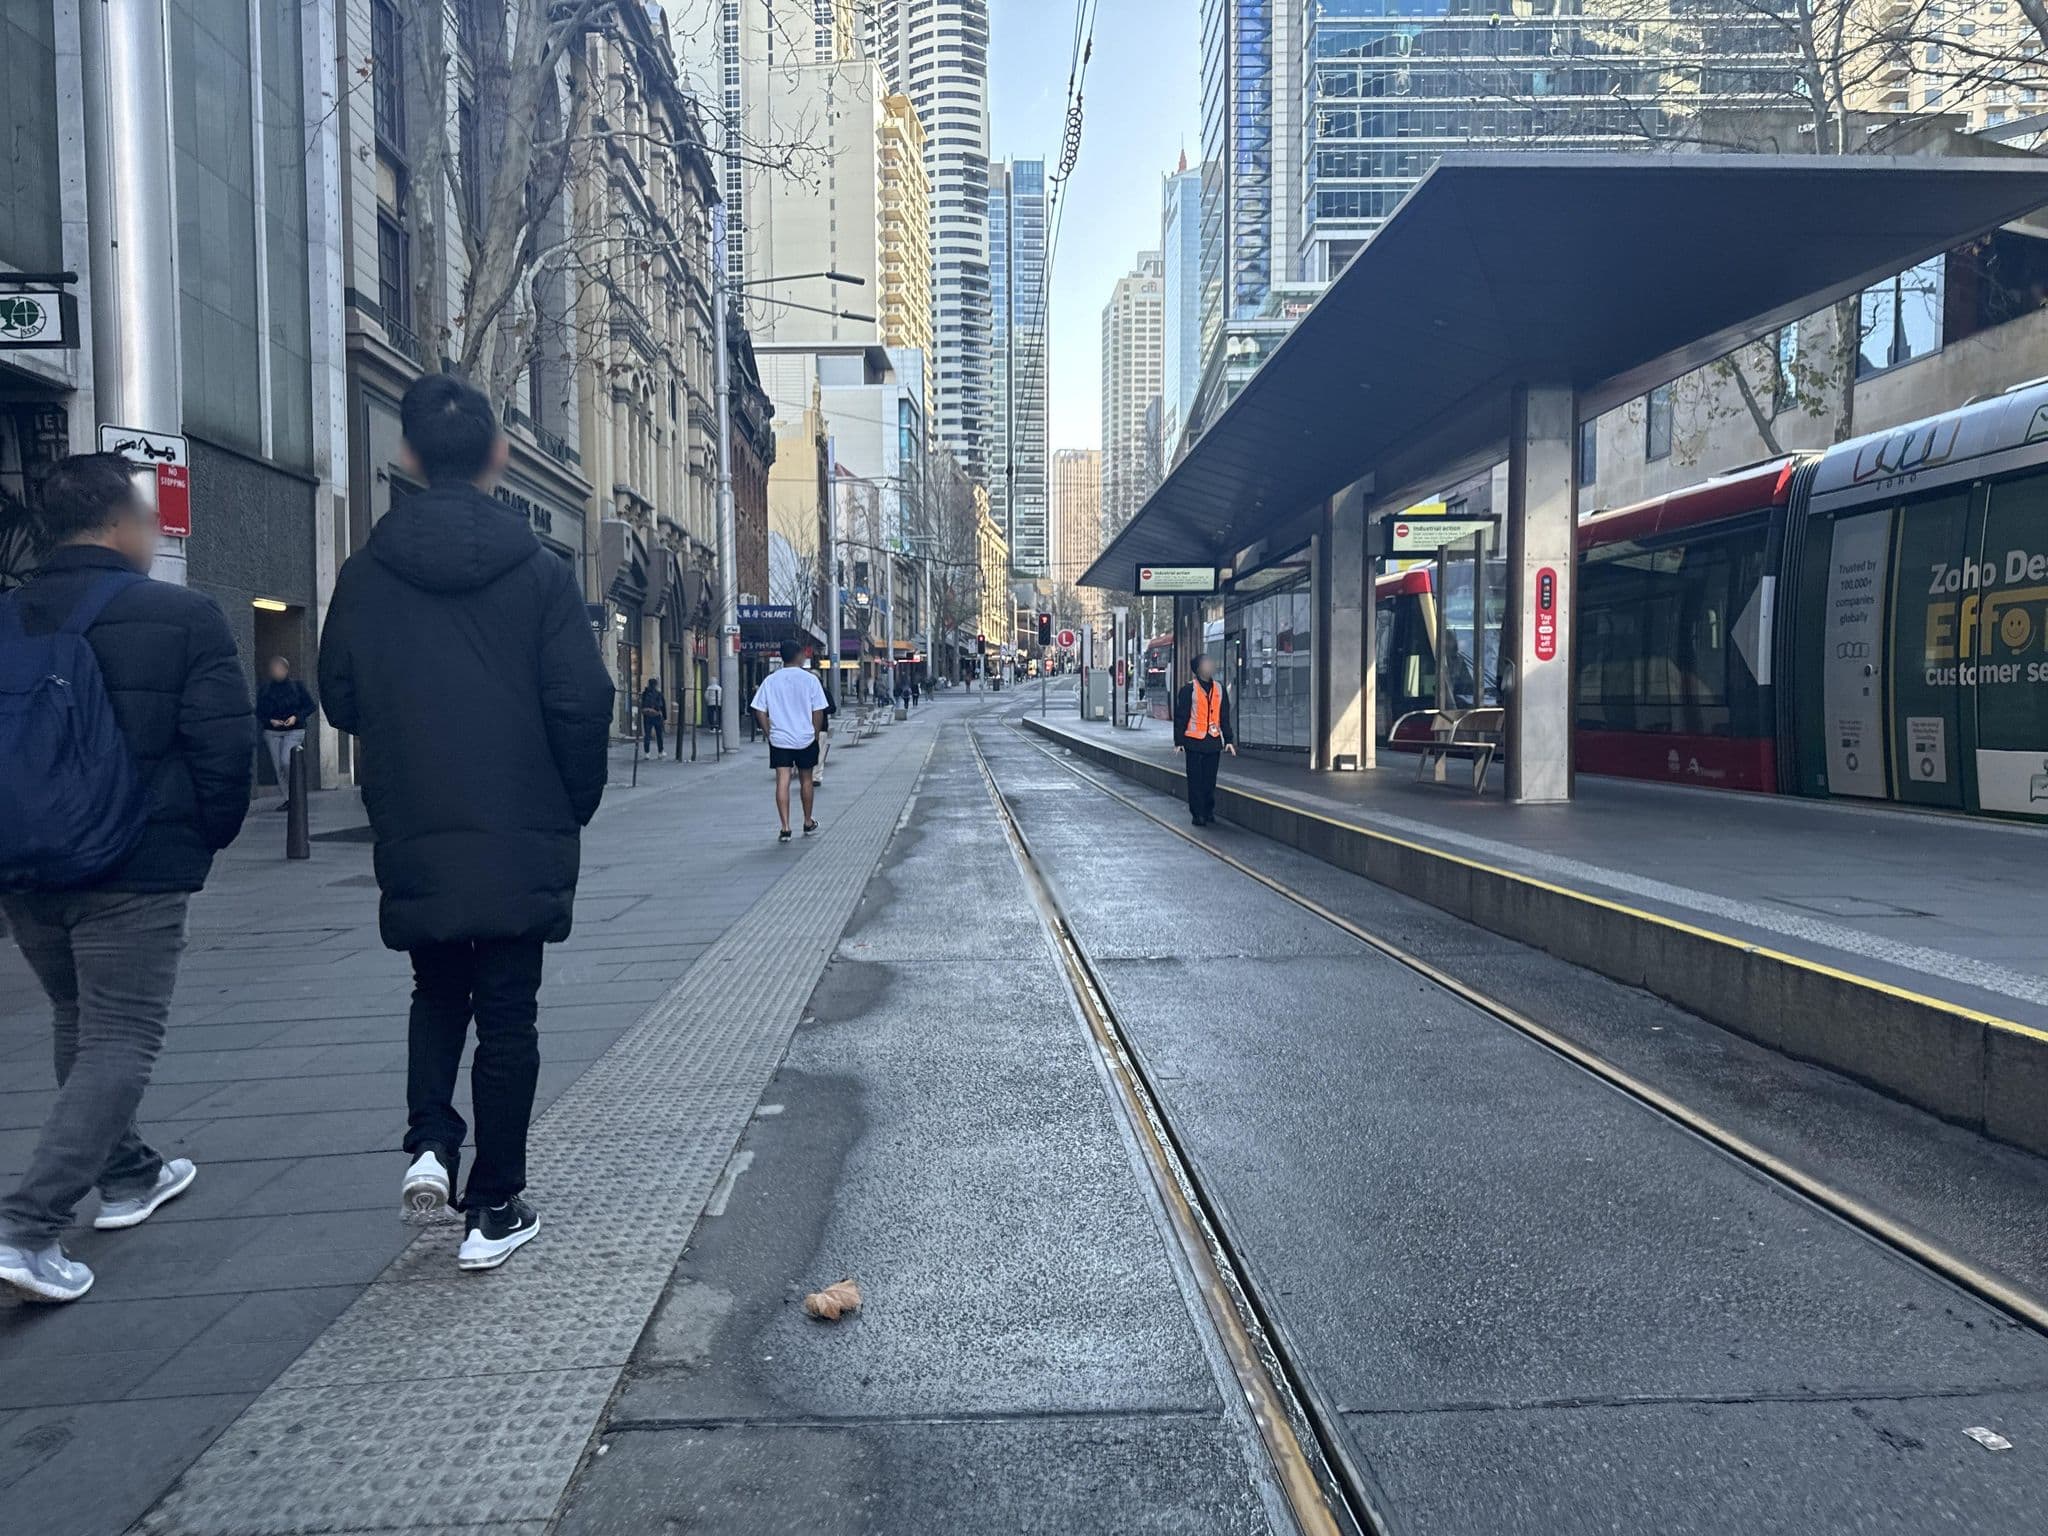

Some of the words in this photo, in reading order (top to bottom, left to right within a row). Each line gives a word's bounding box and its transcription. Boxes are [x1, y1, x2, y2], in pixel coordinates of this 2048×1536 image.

[168, 467, 178, 476] NO
[161, 477, 186, 488] STOPPING
[533, 504, 552, 534] BAR
[1840, 561, 1866, 574] Trusted
[1867, 560, 1876, 571] by
[1929, 557, 1997, 594] Zoho
[2005, 550, 2048, 584] De
[1836, 594, 1875, 608] companies
[1840, 611, 1868, 626] globally
[1925, 586, 2048, 660] Effo
[1062, 634, 1070, 645] L
[1925, 662, 2021, 686] customer
